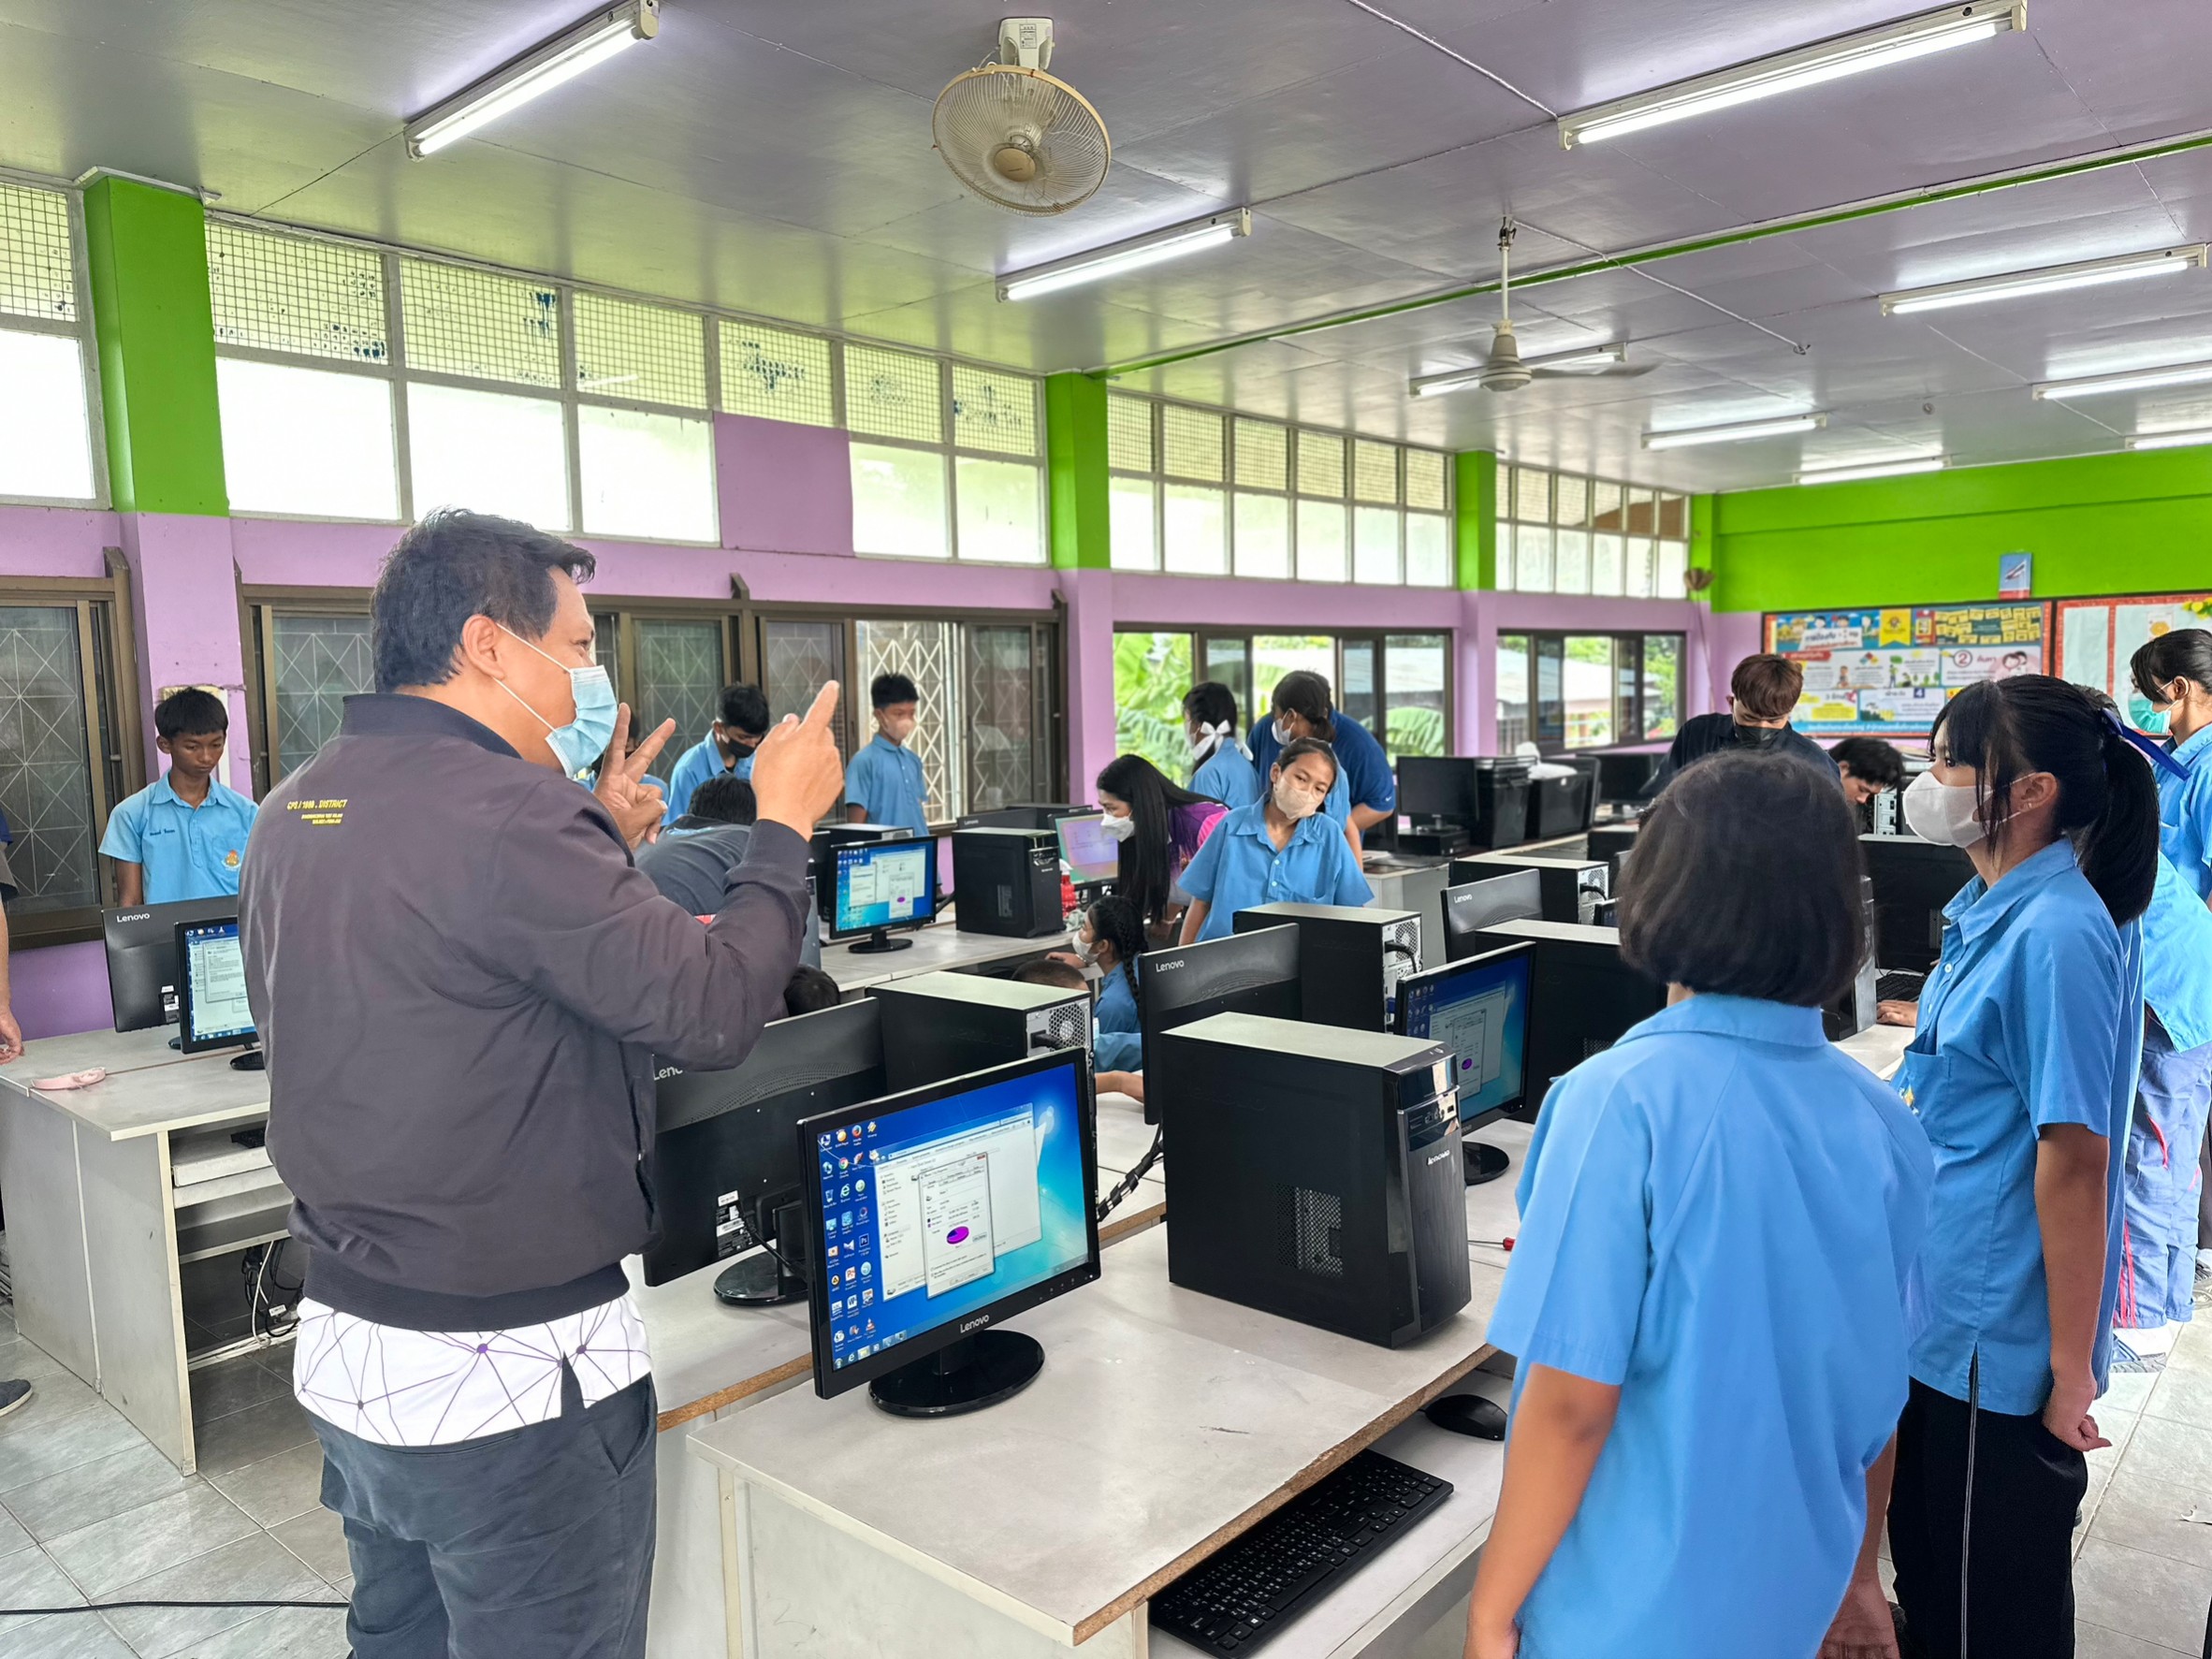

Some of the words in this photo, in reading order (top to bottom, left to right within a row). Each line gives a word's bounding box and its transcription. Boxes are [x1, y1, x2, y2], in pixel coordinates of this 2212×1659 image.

[1958, 652, 1968, 664] 2
[318, 799, 348, 808] DISTRICT
[1453, 894, 1473, 904] Lenovo
[116, 911, 151, 924] Lenovo
[1156, 959, 1185, 972] Lenovo
[960, 1313, 990, 1333] Lenovo
